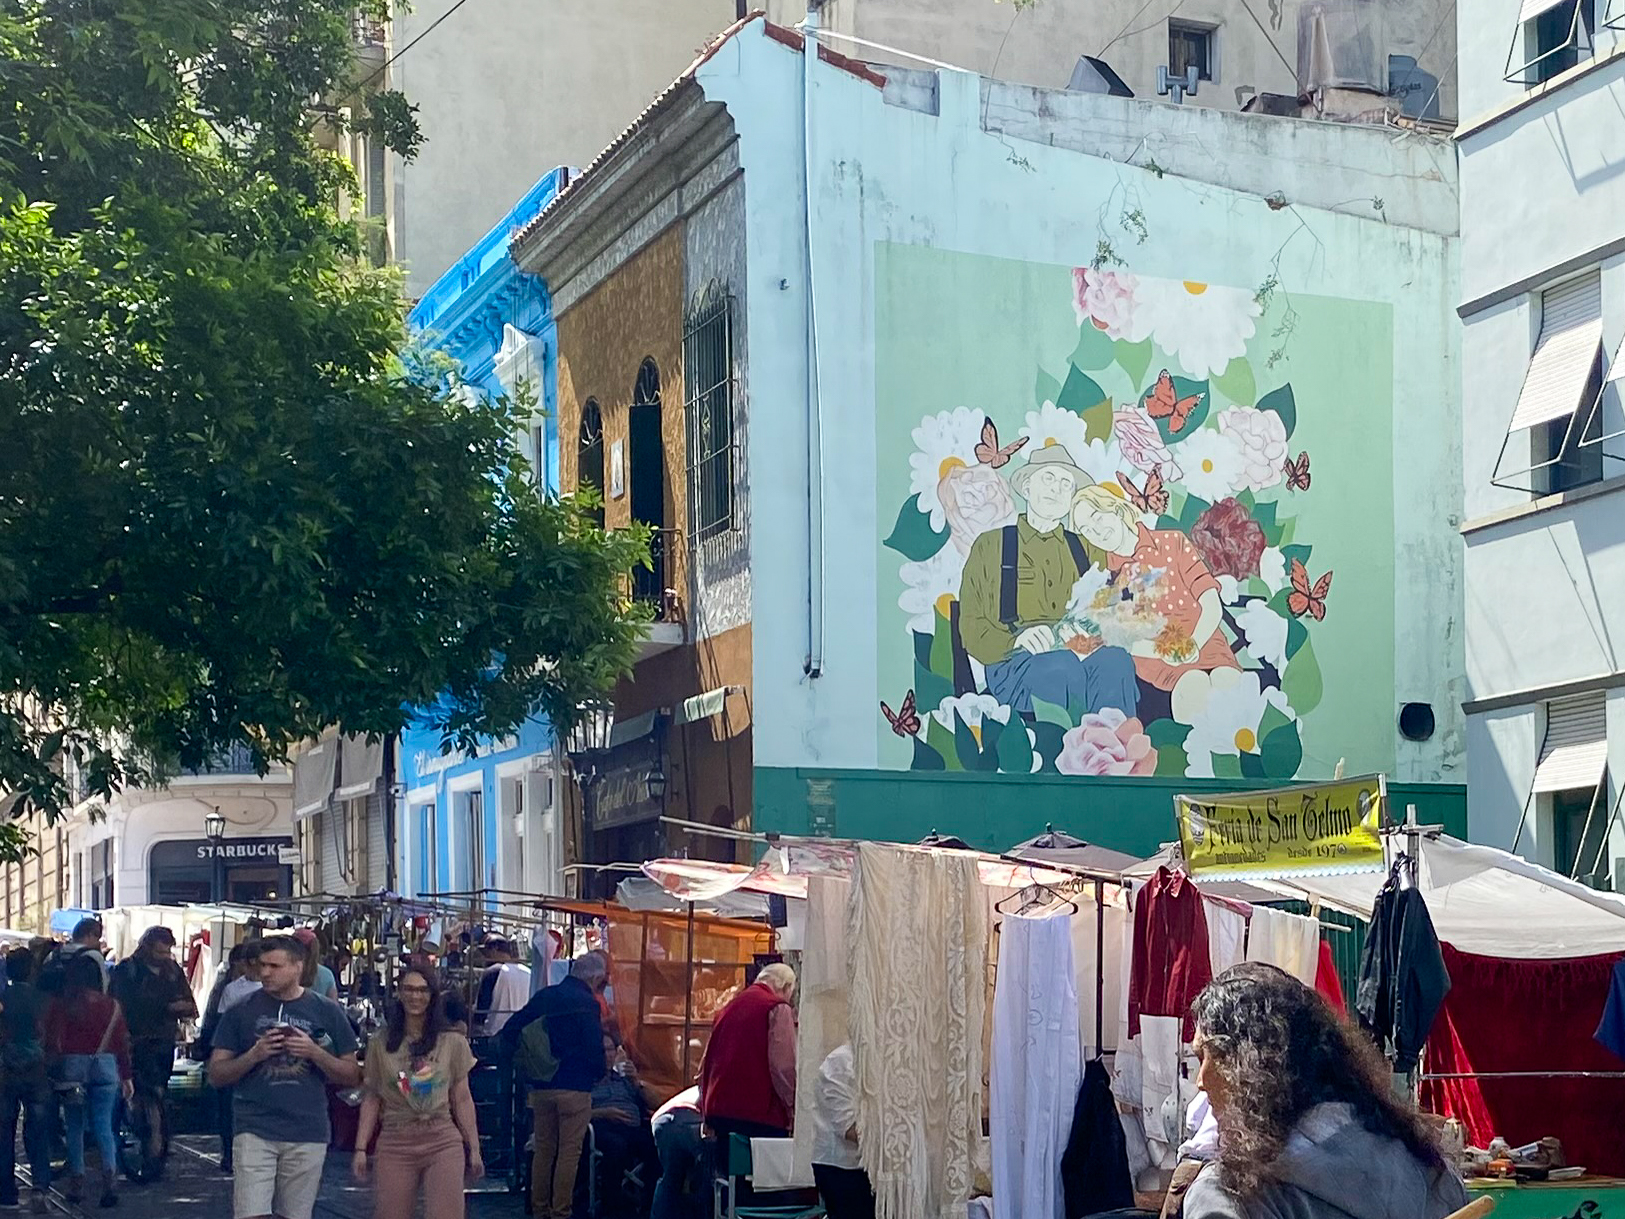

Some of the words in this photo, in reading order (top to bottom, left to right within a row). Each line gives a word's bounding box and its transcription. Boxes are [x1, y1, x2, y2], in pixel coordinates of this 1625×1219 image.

[1204, 803, 1243, 854] Feria
[1247, 806, 1263, 844] de
[1266, 796, 1298, 850] San
[1301, 792, 1352, 842] Telmo
[1287, 847, 1312, 859] desde
